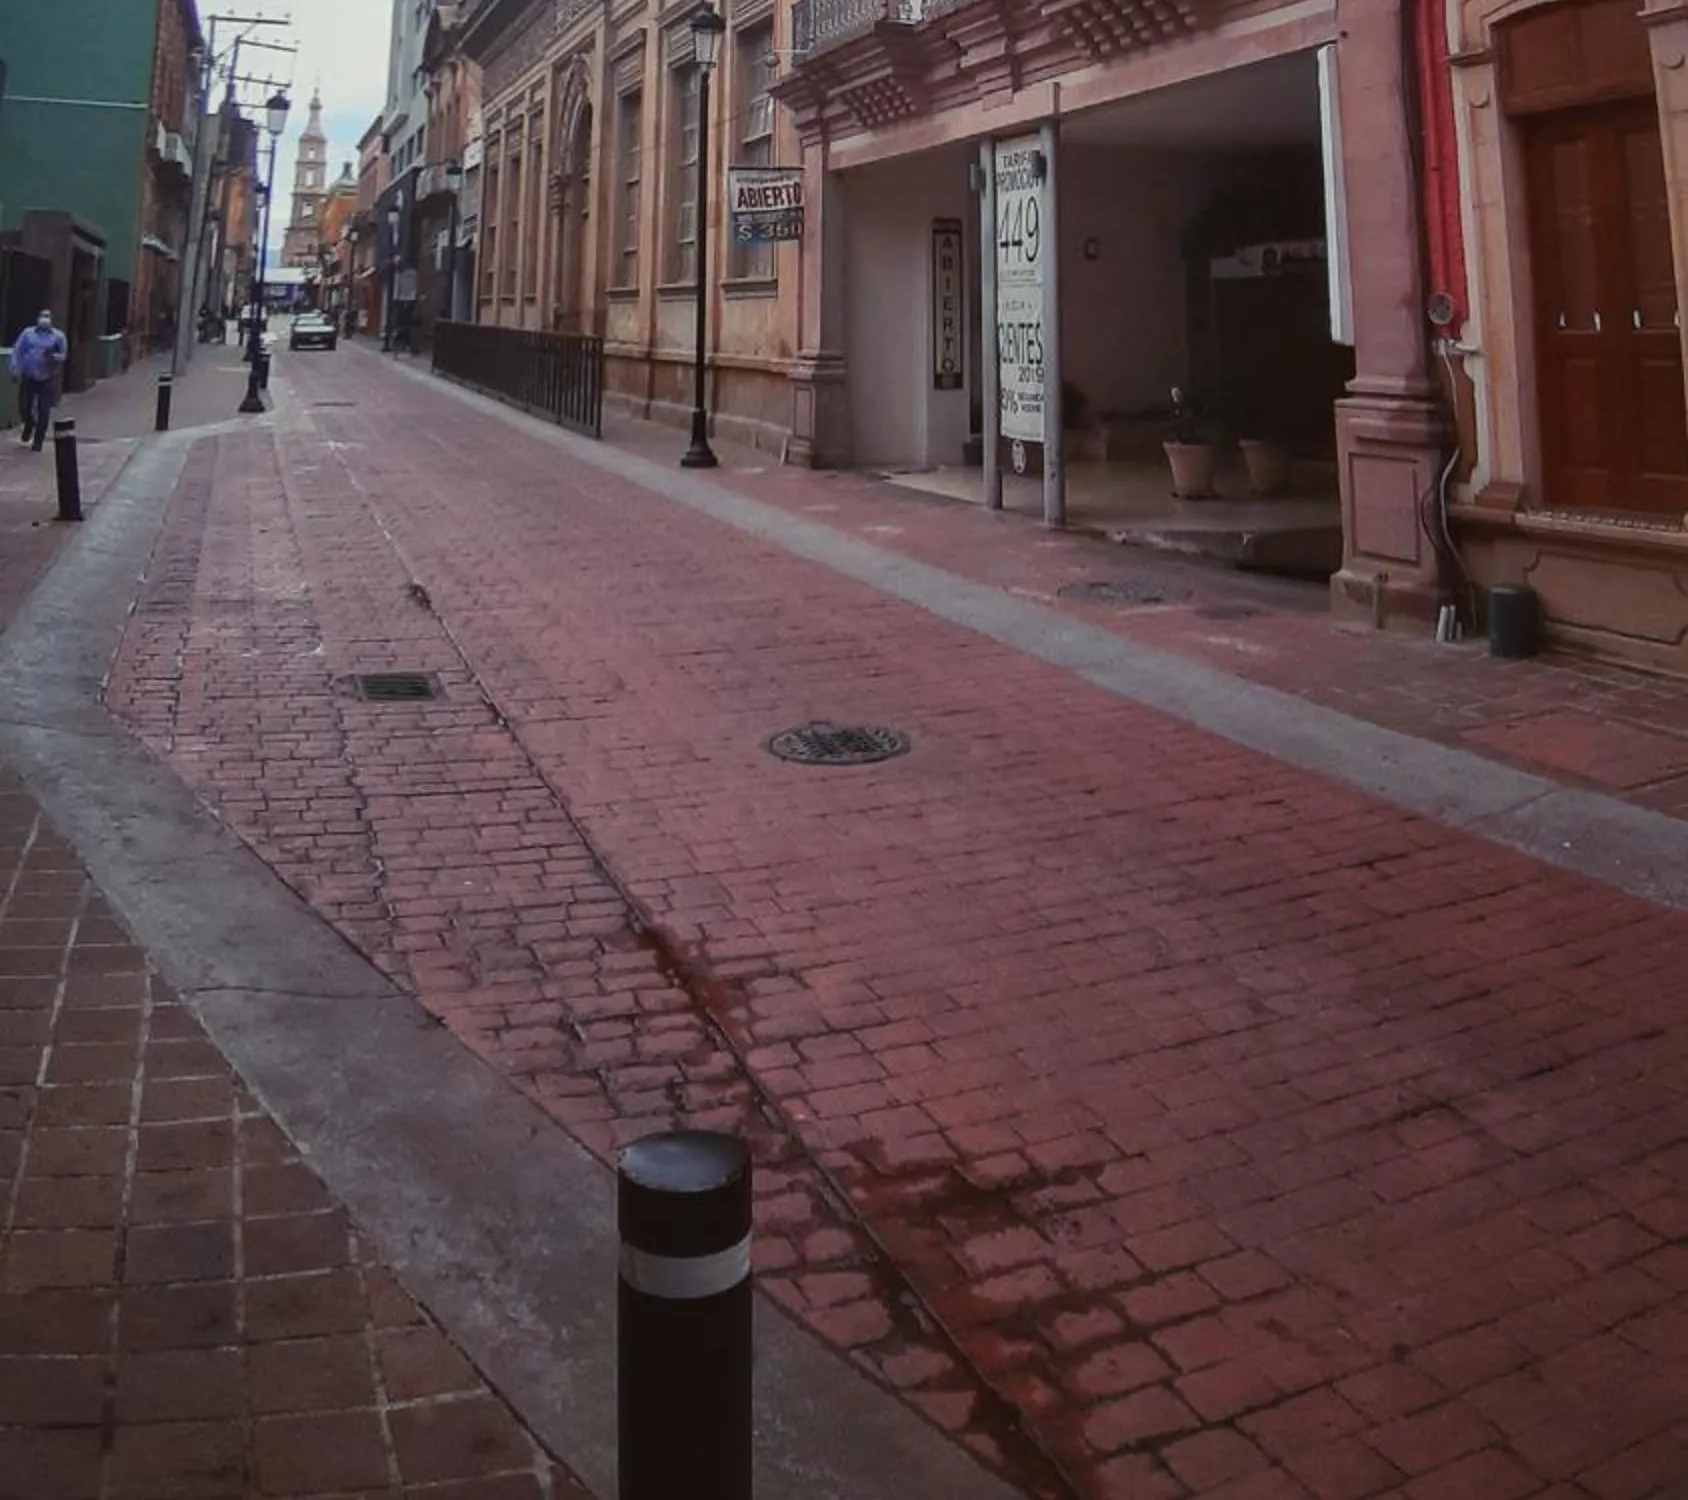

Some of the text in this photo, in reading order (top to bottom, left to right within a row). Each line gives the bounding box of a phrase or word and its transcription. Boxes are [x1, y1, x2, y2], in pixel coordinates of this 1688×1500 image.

[737, 181, 802, 209] ABIERTO
[999, 196, 1040, 263] 449
[942, 235, 955, 373] ABIERTO
[1018, 364, 1045, 383] 2019
